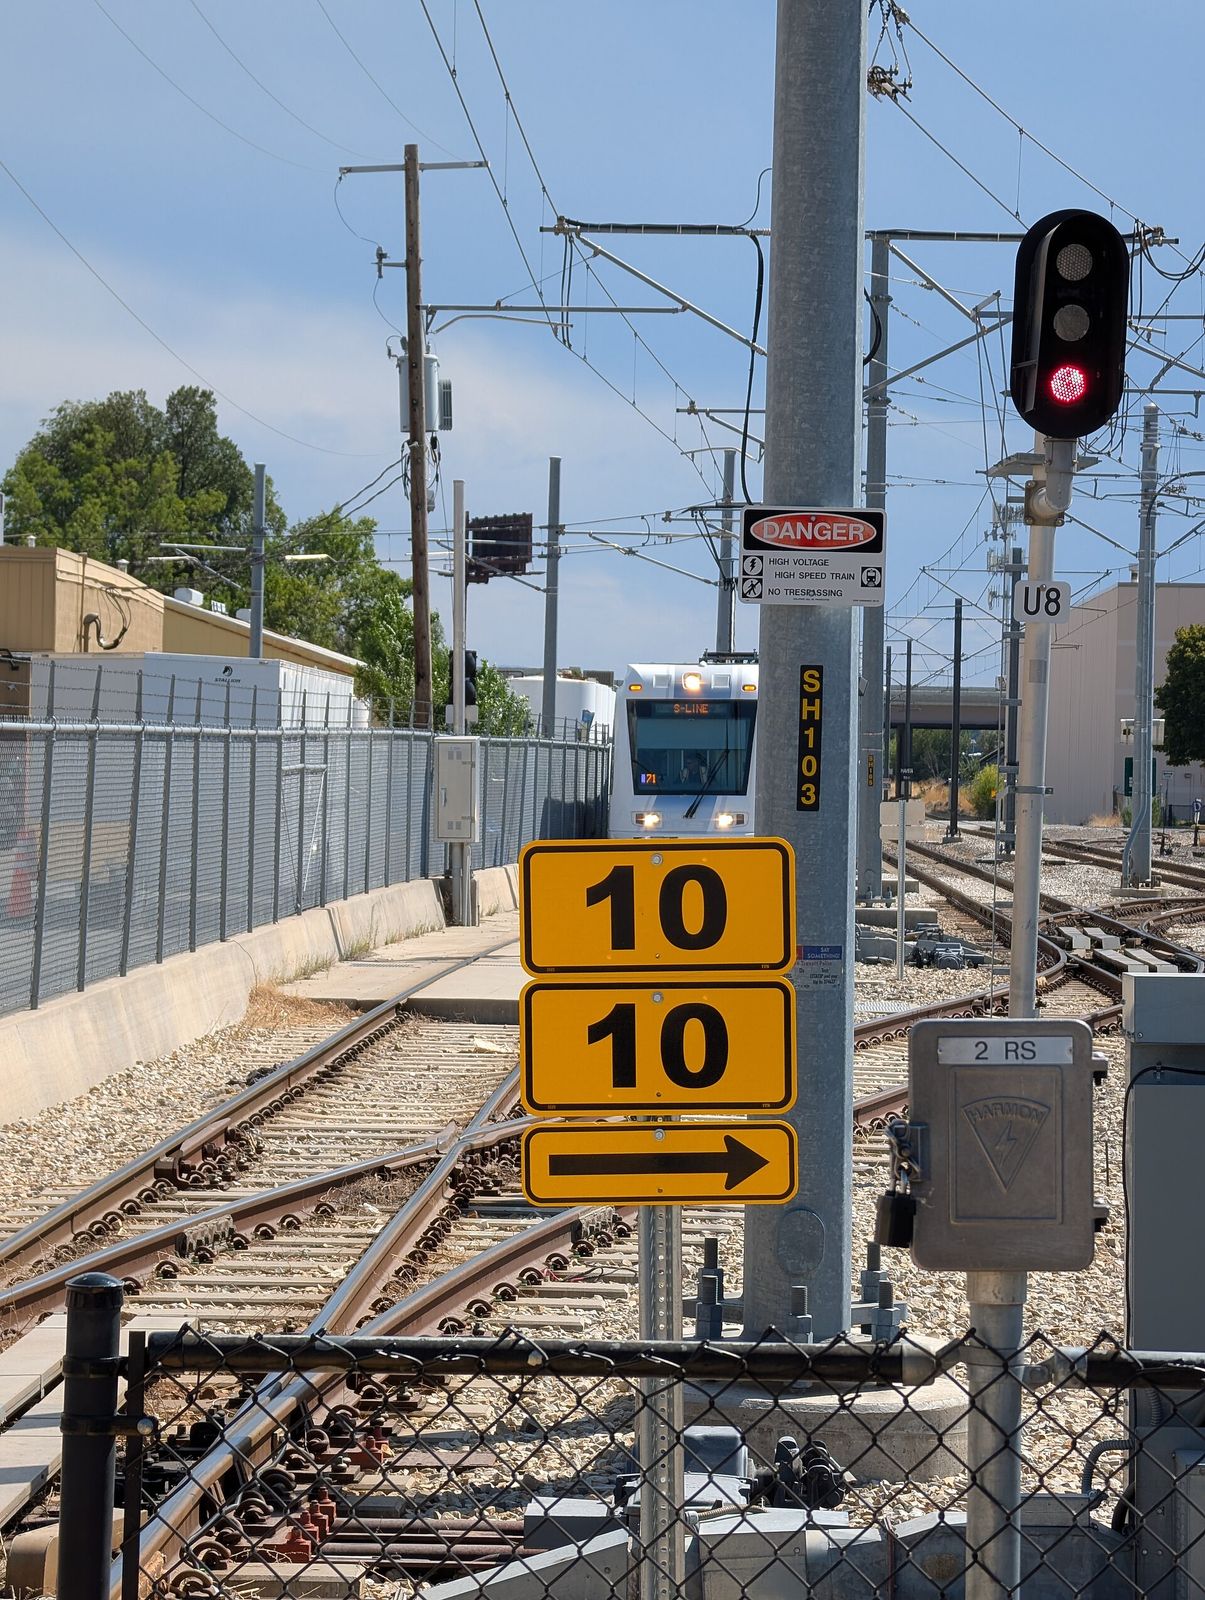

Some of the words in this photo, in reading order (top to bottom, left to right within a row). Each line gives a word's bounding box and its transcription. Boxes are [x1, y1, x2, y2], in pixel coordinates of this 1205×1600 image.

[763, 522, 864, 540] DANGER
[769, 558, 789, 566] HIGH
[793, 558, 830, 567] VOLTAGE
[774, 571, 795, 579] HIGH
[798, 571, 827, 580] SPEED
[830, 572, 856, 581] TRAIN
[767, 588, 781, 596] NO
[784, 588, 843, 597] TRESPASSING
[1024, 586, 1061, 616] U8
[673, 703, 709, 713] S-LINE
[801, 669, 820, 805] SH103
[586, 864, 728, 951] 10
[587, 1002, 729, 1089] 10
[975, 1041, 989, 1060] 2
[1004, 1040, 1037, 1060] RS
[969, 1102, 1046, 1122] HARMON
